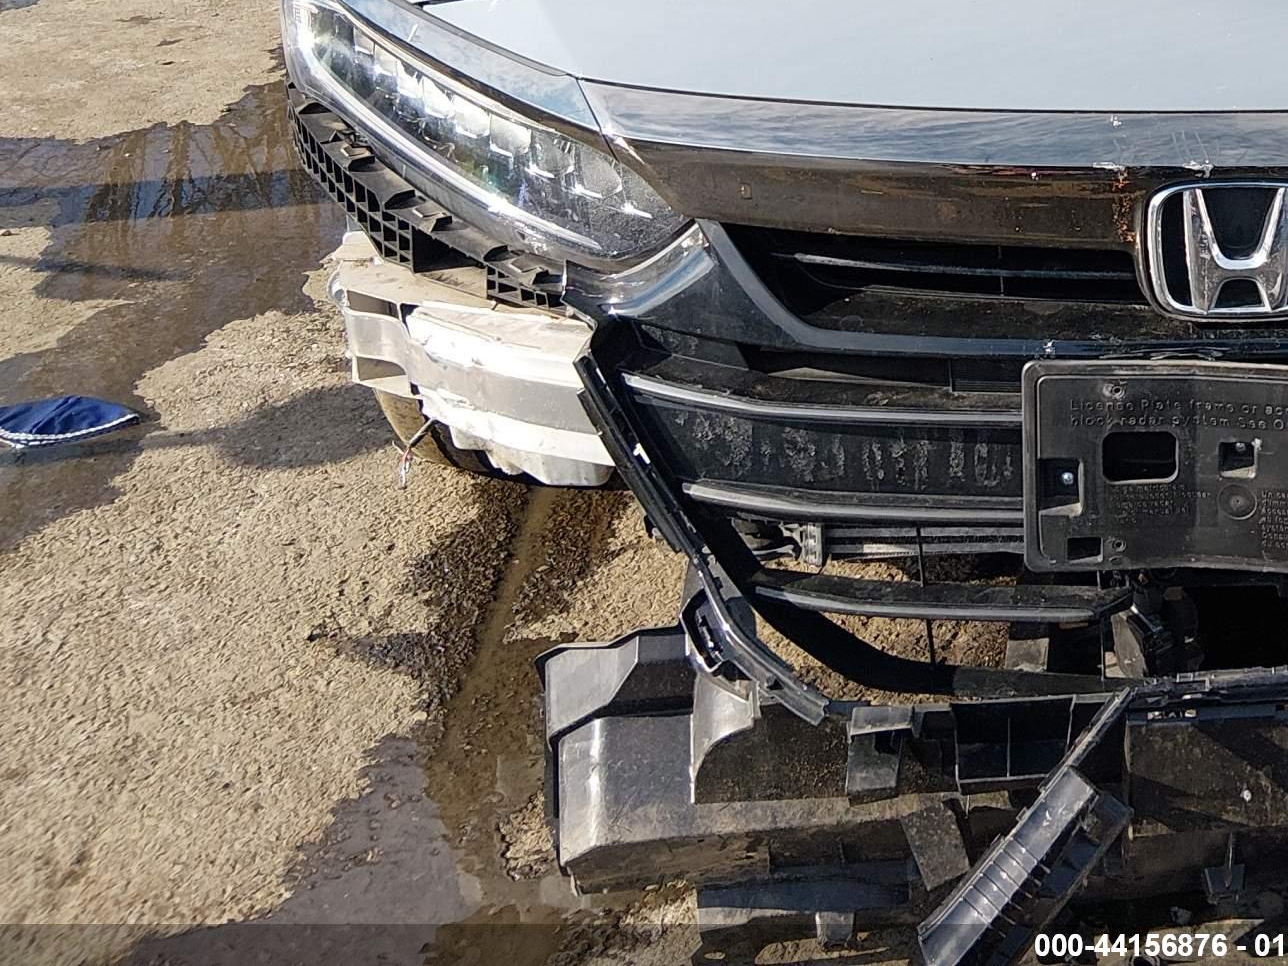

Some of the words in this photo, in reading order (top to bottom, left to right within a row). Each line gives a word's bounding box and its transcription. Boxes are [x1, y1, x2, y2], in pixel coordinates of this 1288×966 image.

[1141, 399, 1182, 411] Plate
[1189, 398, 1234, 413] frame
[1241, 404, 1257, 414] or
[1120, 414, 1164, 427] radar
